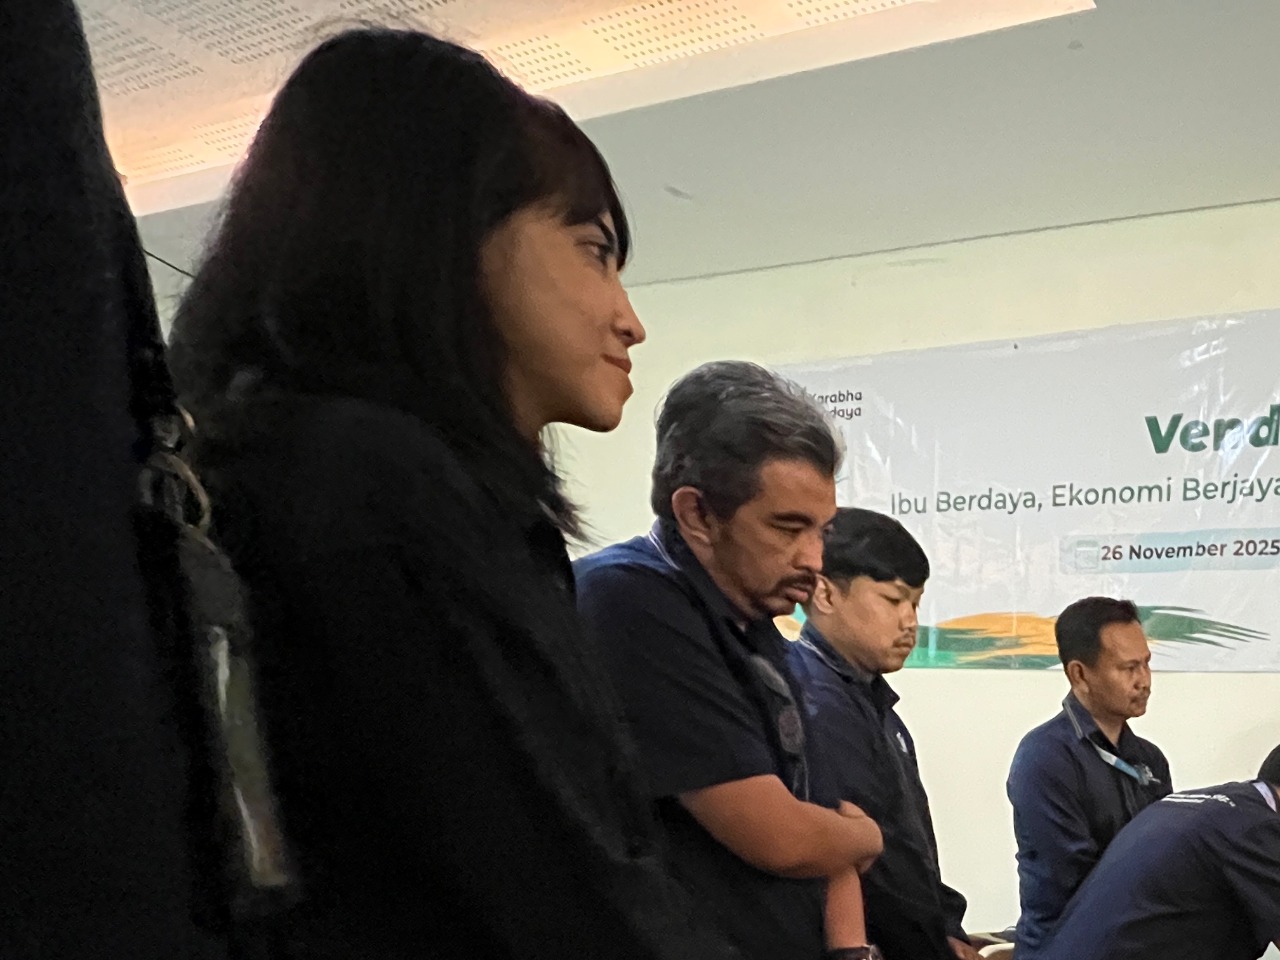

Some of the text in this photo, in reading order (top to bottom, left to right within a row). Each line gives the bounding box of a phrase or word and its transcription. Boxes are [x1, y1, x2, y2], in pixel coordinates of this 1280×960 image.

[812, 389, 863, 405] arabha
[890, 492, 928, 516] Ibu
[935, 487, 1043, 517] Berdaya,
[1051, 476, 1173, 508] Ekonomi
[1100, 544, 1124, 562] 26
[1128, 540, 1228, 561] November
